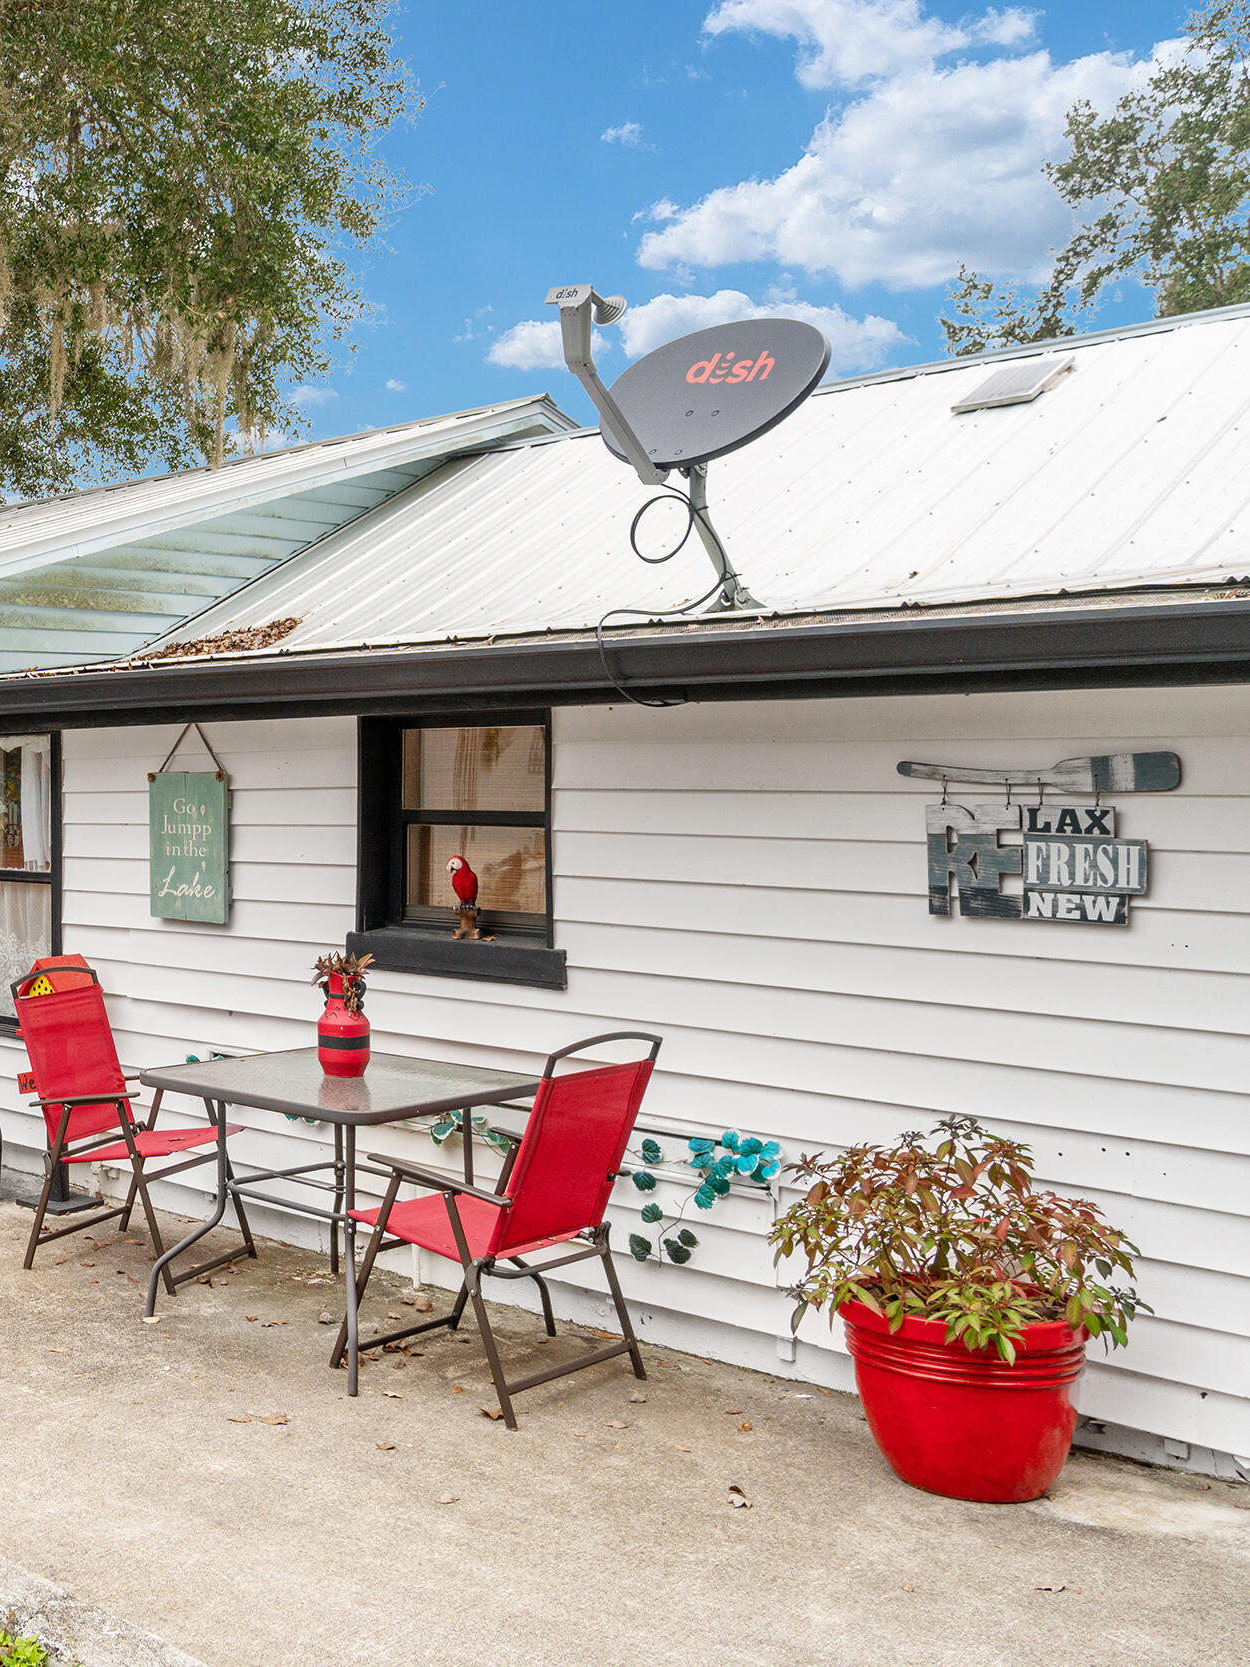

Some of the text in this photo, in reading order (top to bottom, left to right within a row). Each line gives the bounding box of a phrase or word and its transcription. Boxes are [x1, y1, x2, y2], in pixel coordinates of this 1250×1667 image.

[556, 287, 578, 299] dish
[686, 350, 775, 384] dish
[173, 798, 196, 814] Go
[161, 815, 212, 841] Jumpp
[1026, 807, 1111, 835] LAX
[165, 838, 207, 857] in the
[1025, 840, 1146, 889] FRESH
[157, 865, 216, 898] Lake
[1027, 892, 1120, 922] NEW
